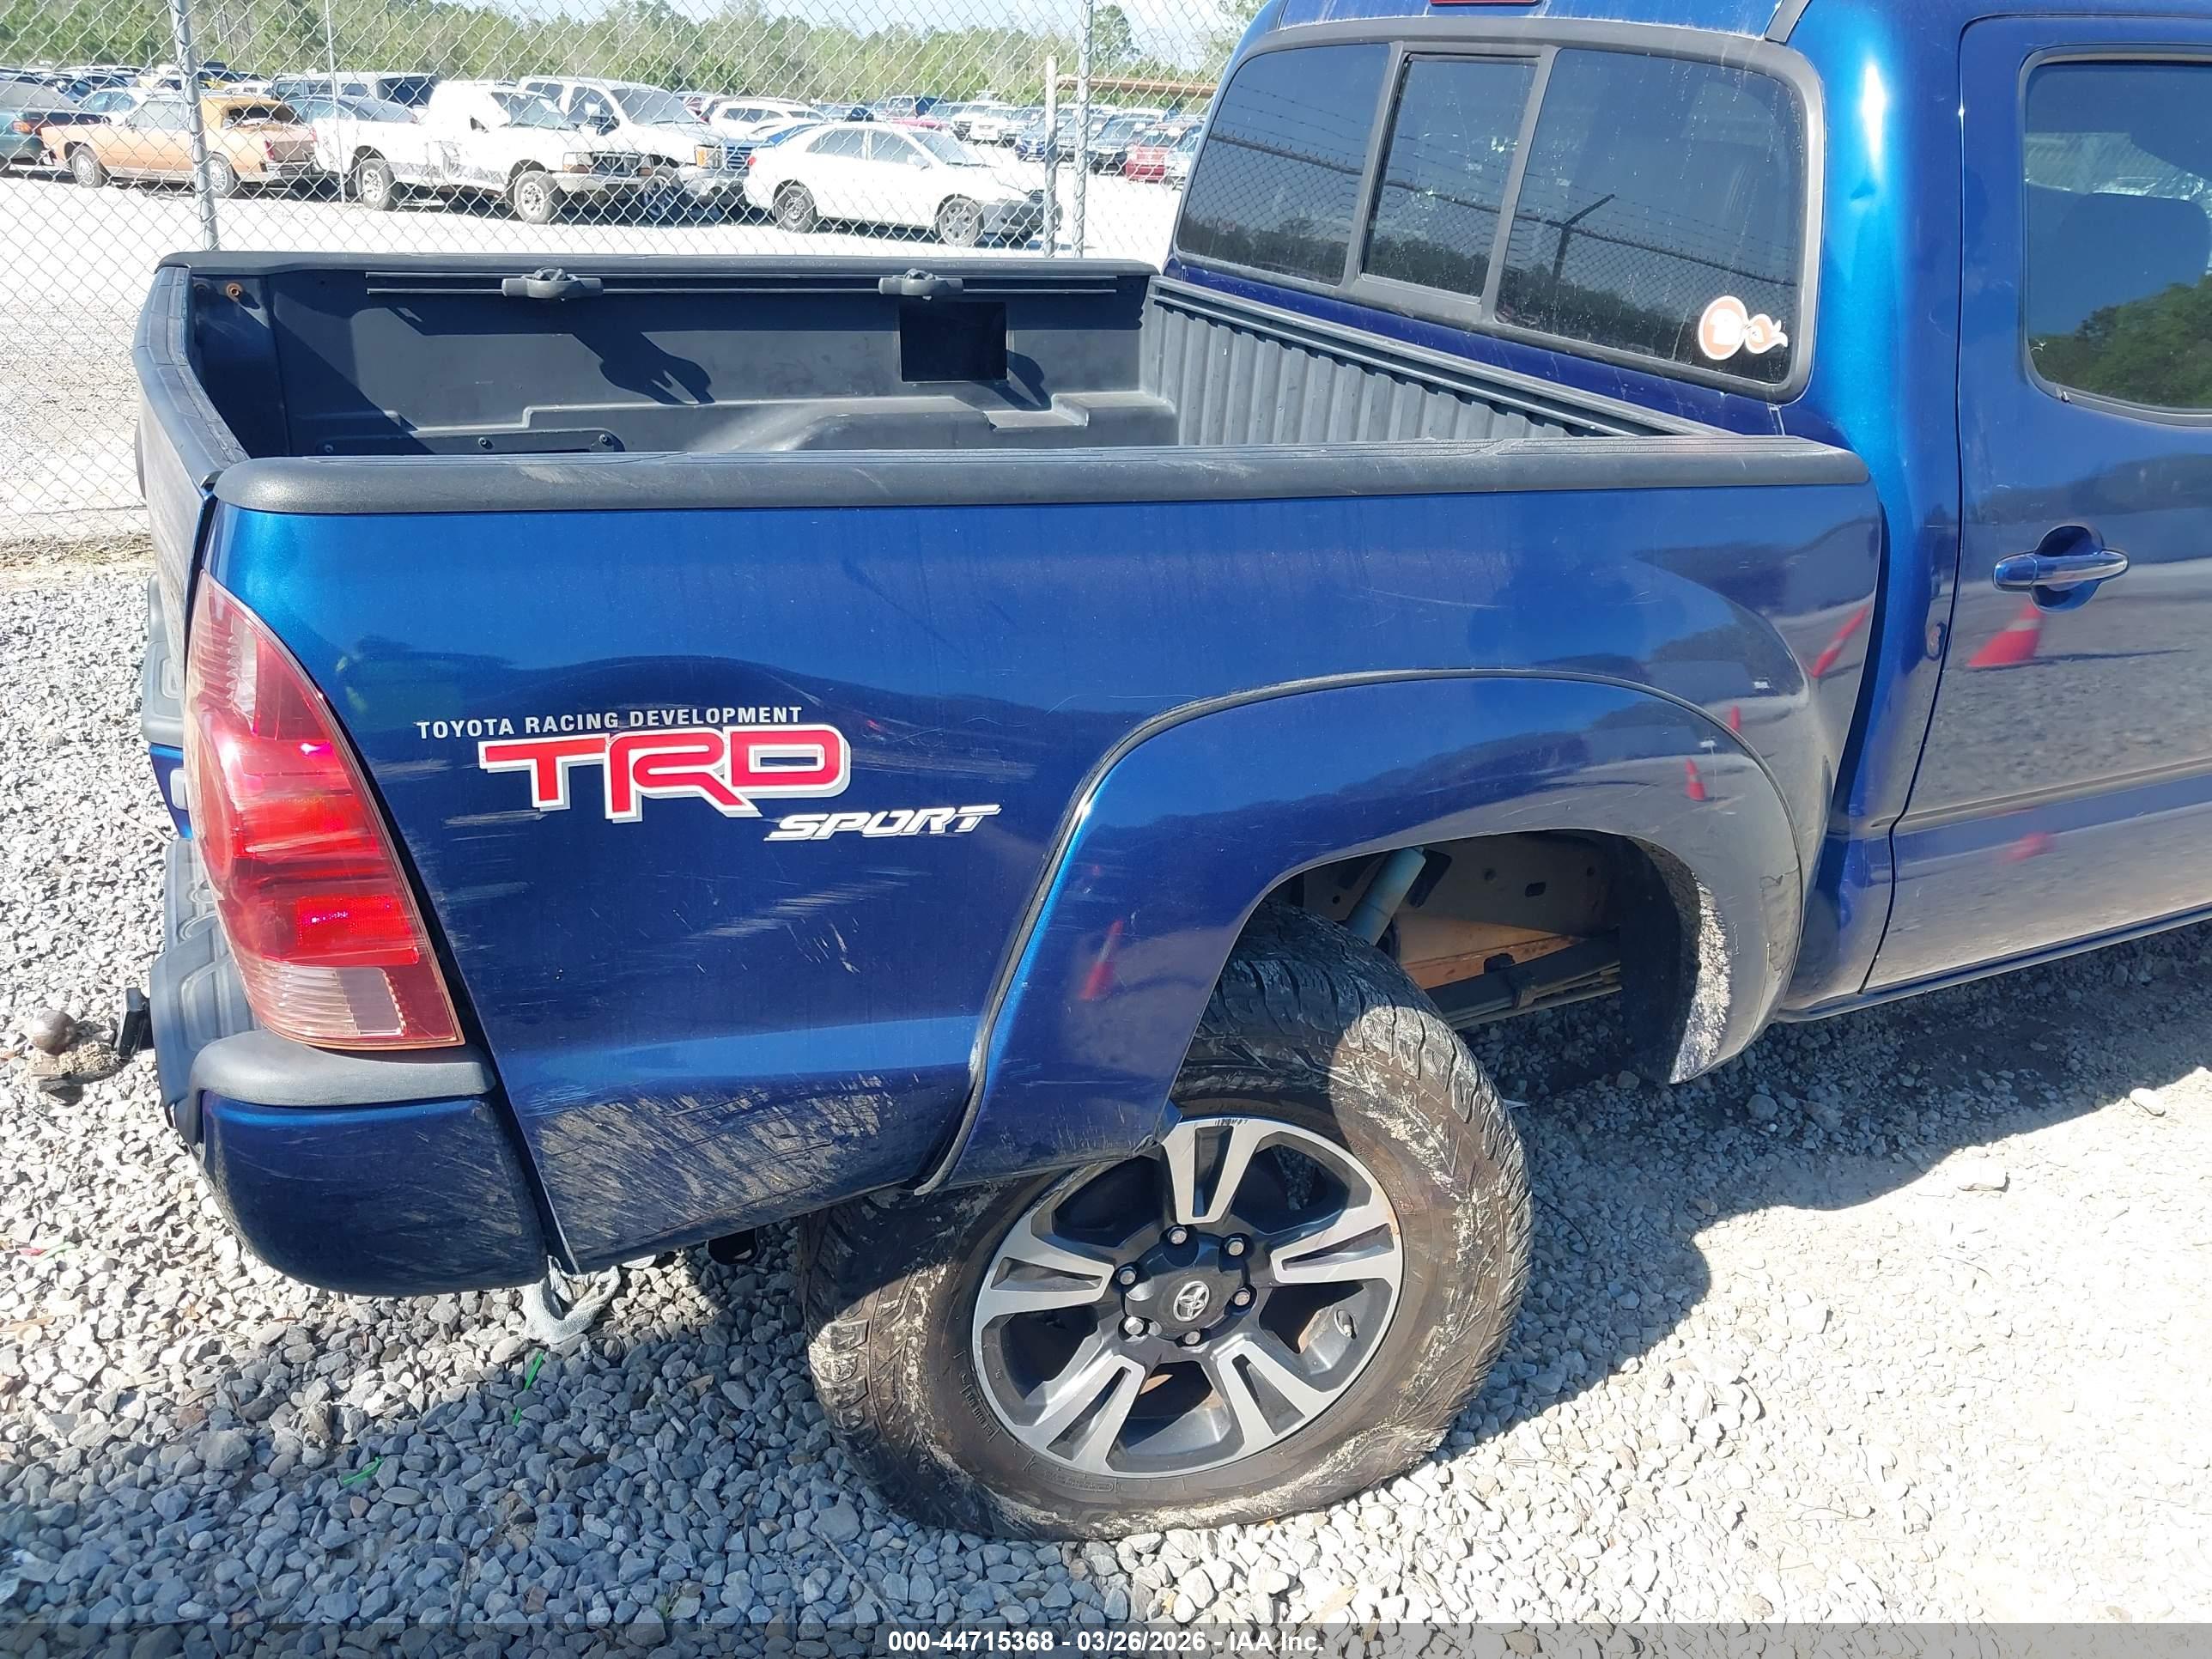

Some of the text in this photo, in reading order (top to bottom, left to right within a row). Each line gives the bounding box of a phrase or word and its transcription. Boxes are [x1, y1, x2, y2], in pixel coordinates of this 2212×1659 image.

[416, 706, 802, 739] TOYOTA RACING DEVELOPMENT
[477, 724, 852, 824] TRD
[763, 804, 1003, 842] SPORT
